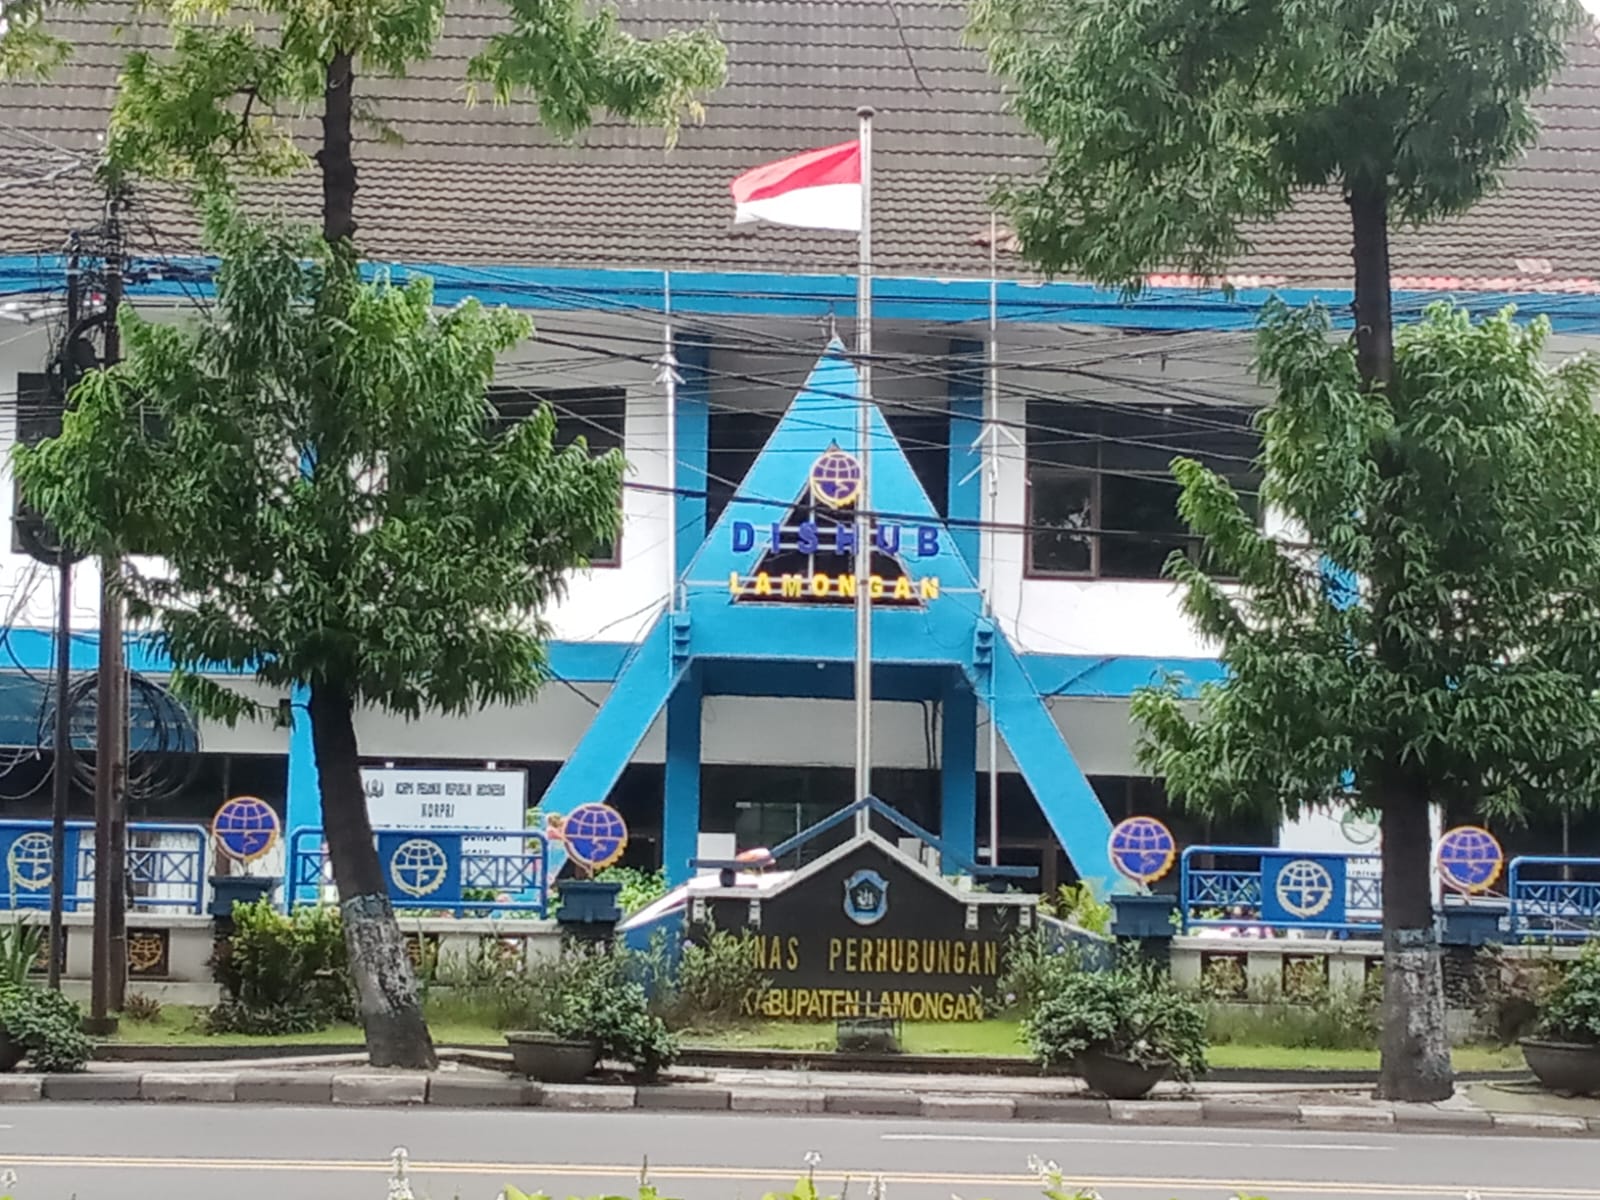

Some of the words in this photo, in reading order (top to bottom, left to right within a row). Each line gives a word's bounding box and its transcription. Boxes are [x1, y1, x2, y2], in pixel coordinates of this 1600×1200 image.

[732, 521, 940, 557] DISHUB
[729, 571, 940, 600] LAMONGAN
[829, 937, 998, 976] PERHUBUNGAN
[865, 990, 984, 1021] LAMONGAN
